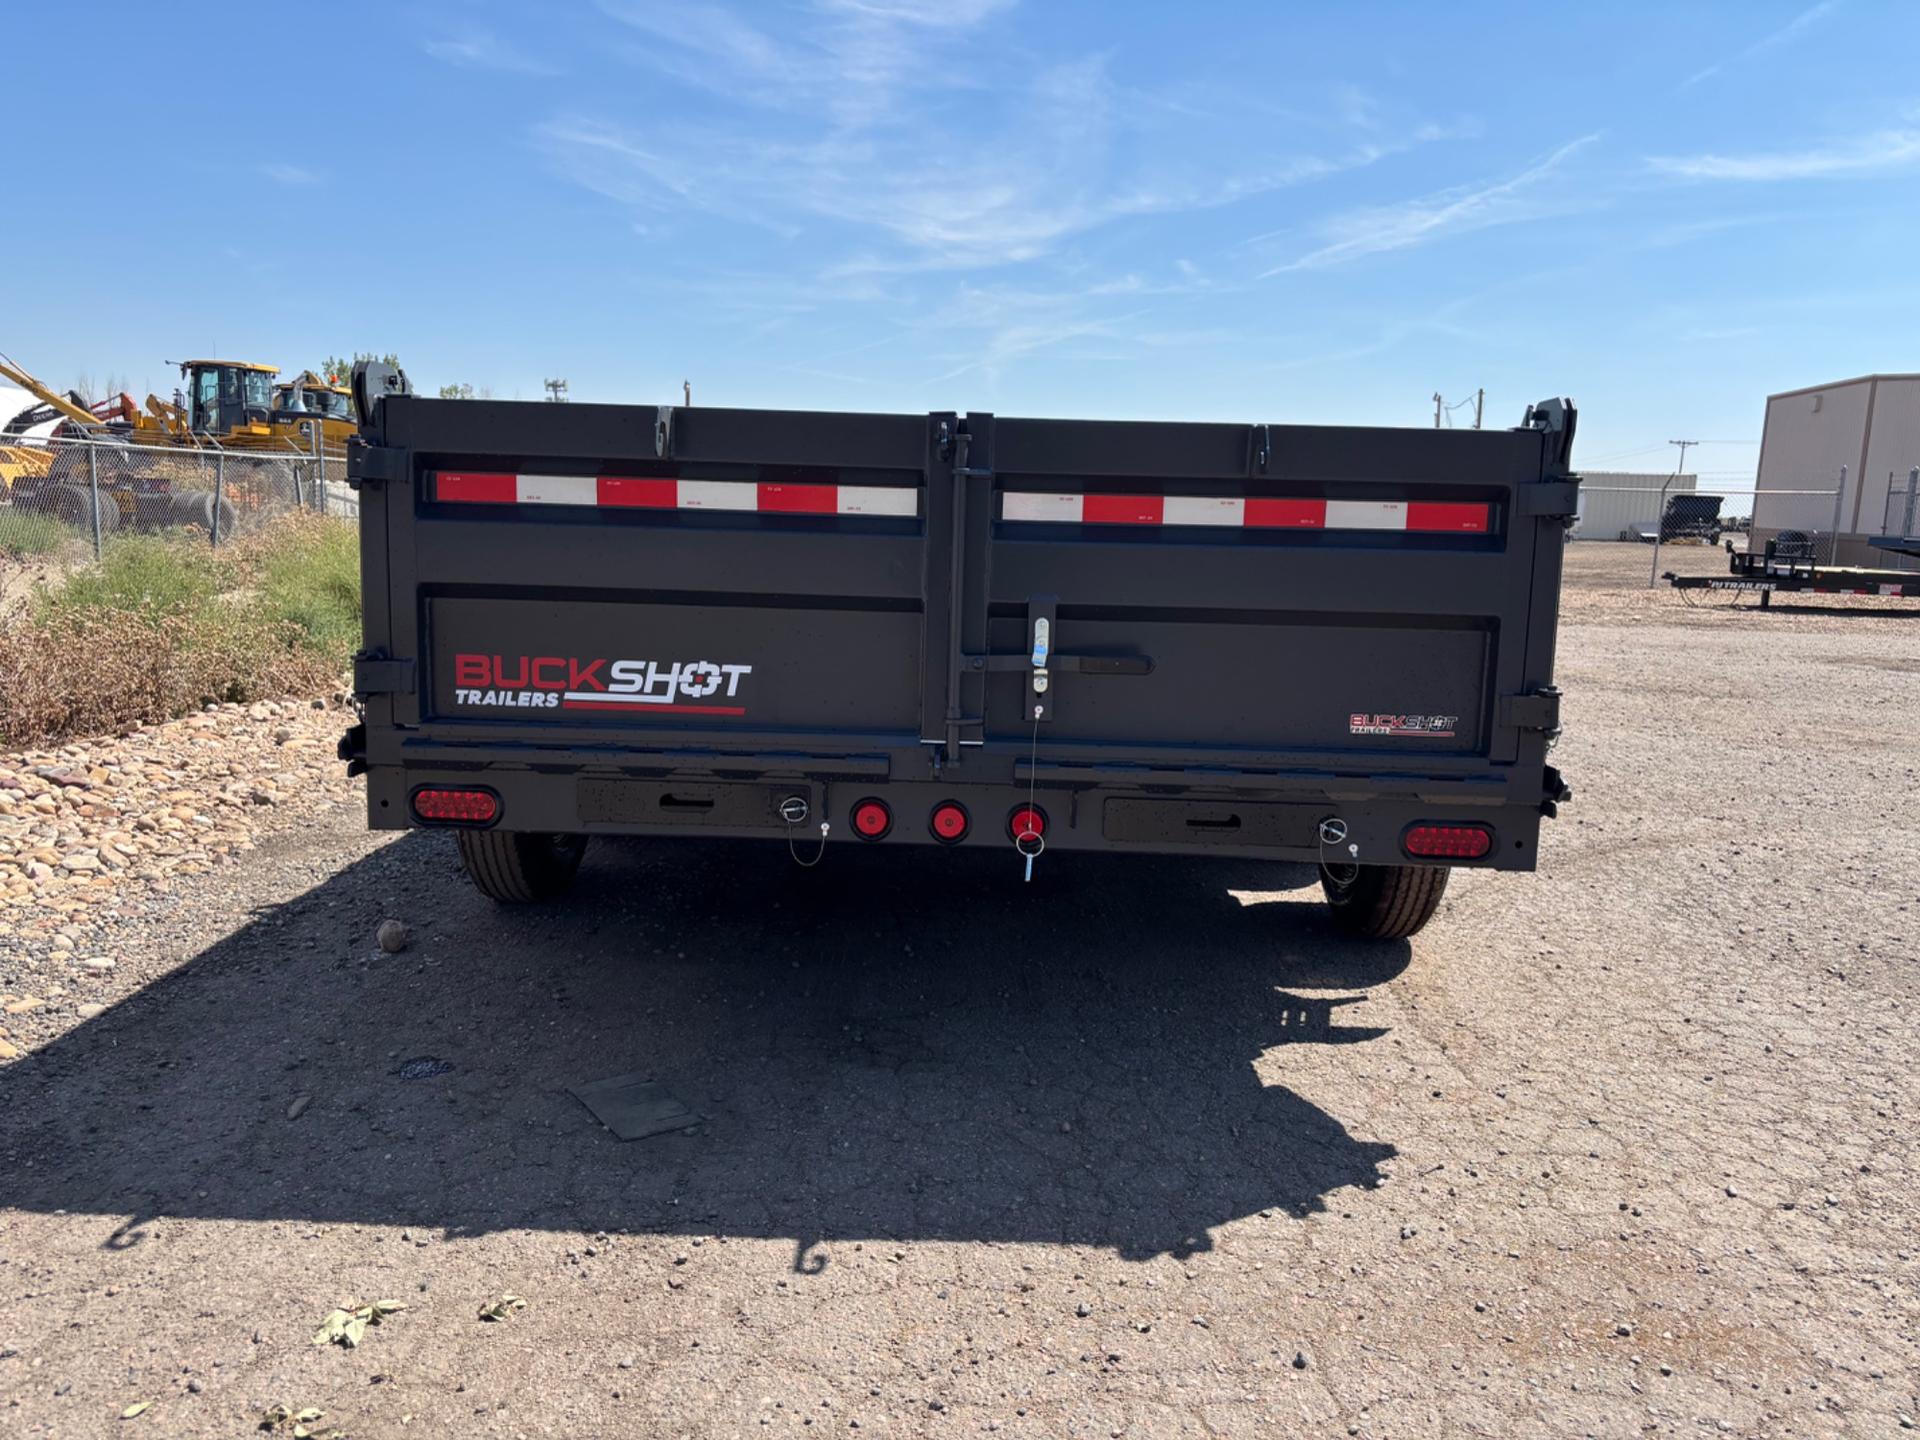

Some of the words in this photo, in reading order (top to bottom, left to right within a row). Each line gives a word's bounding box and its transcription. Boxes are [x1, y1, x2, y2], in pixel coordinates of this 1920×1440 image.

[1723, 582, 1777, 590] TRAILERS
[455, 654, 752, 699] BUCKSHOT
[455, 689, 559, 707] TRAILERS
[1349, 714, 1458, 731] BUCKSHOT
